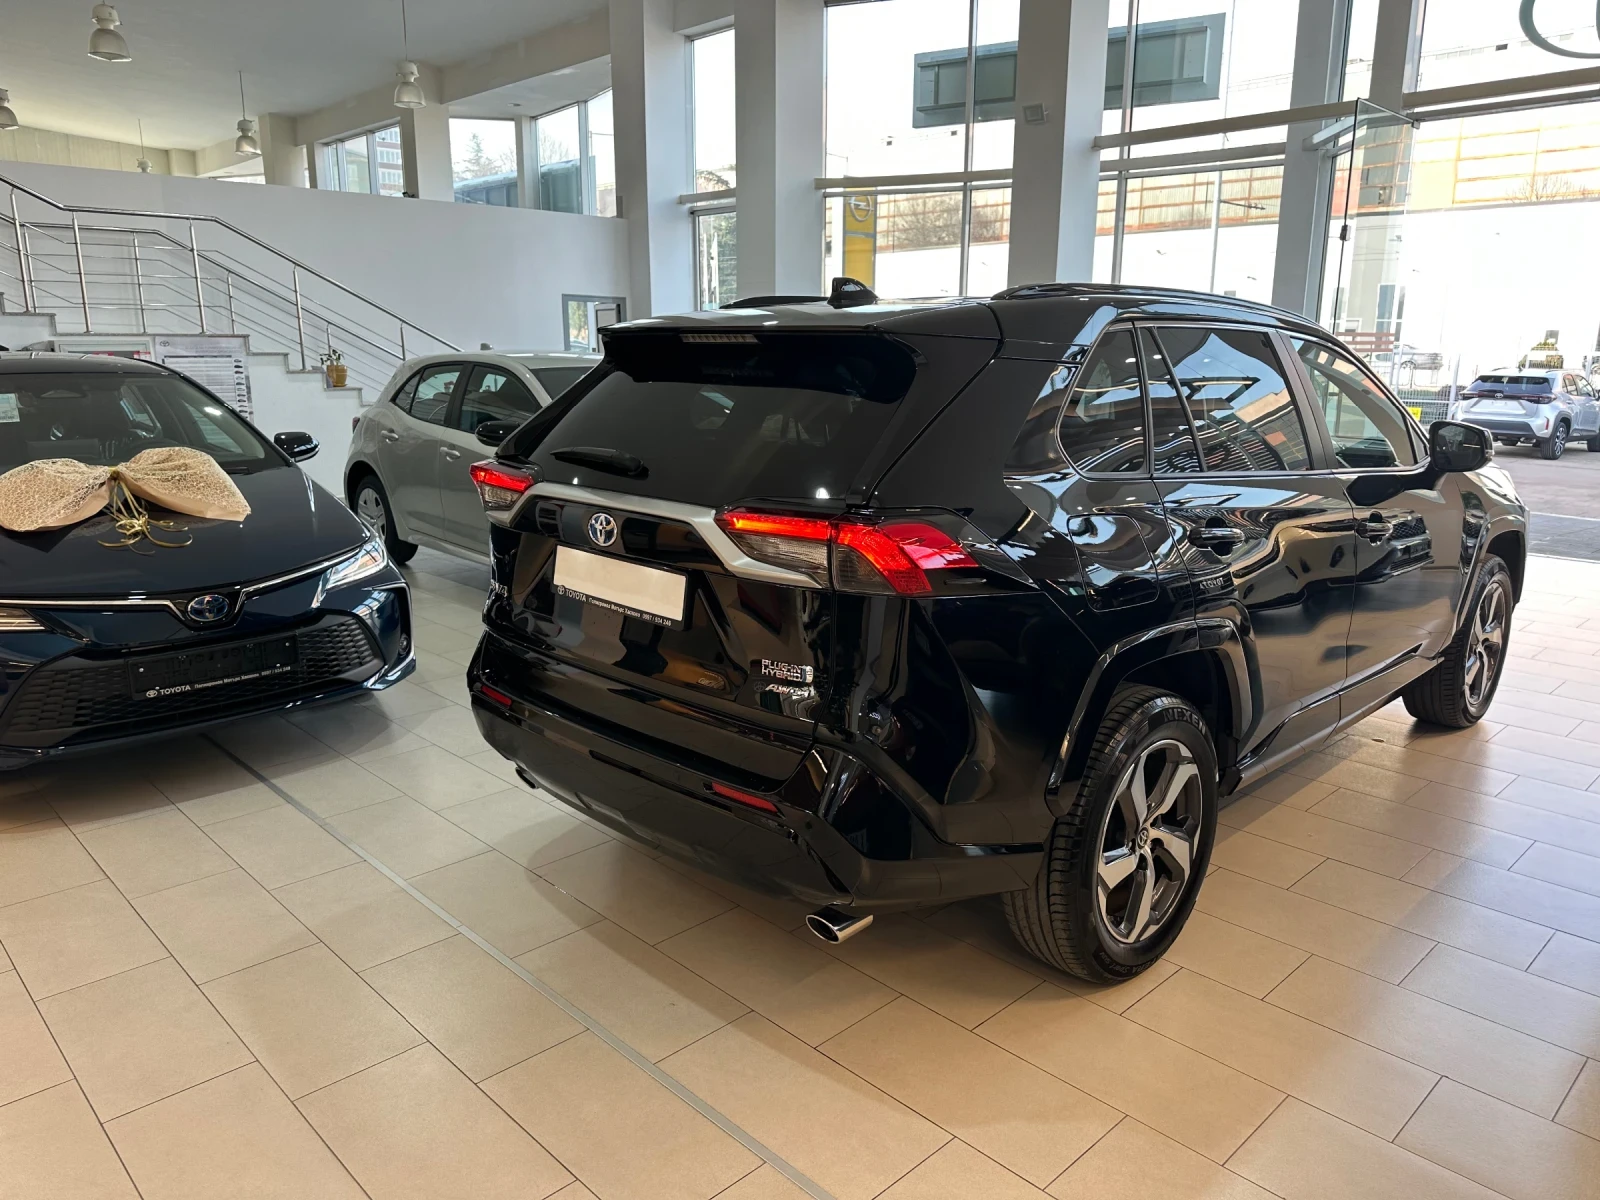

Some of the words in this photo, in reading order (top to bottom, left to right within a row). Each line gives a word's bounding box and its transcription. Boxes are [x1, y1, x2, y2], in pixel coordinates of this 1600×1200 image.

[566, 588, 586, 602] TOYOTA
[761, 665, 803, 682] HYBRID
[160, 685, 191, 695] TOYOTA
[1162, 707, 1207, 736] NEXEN
